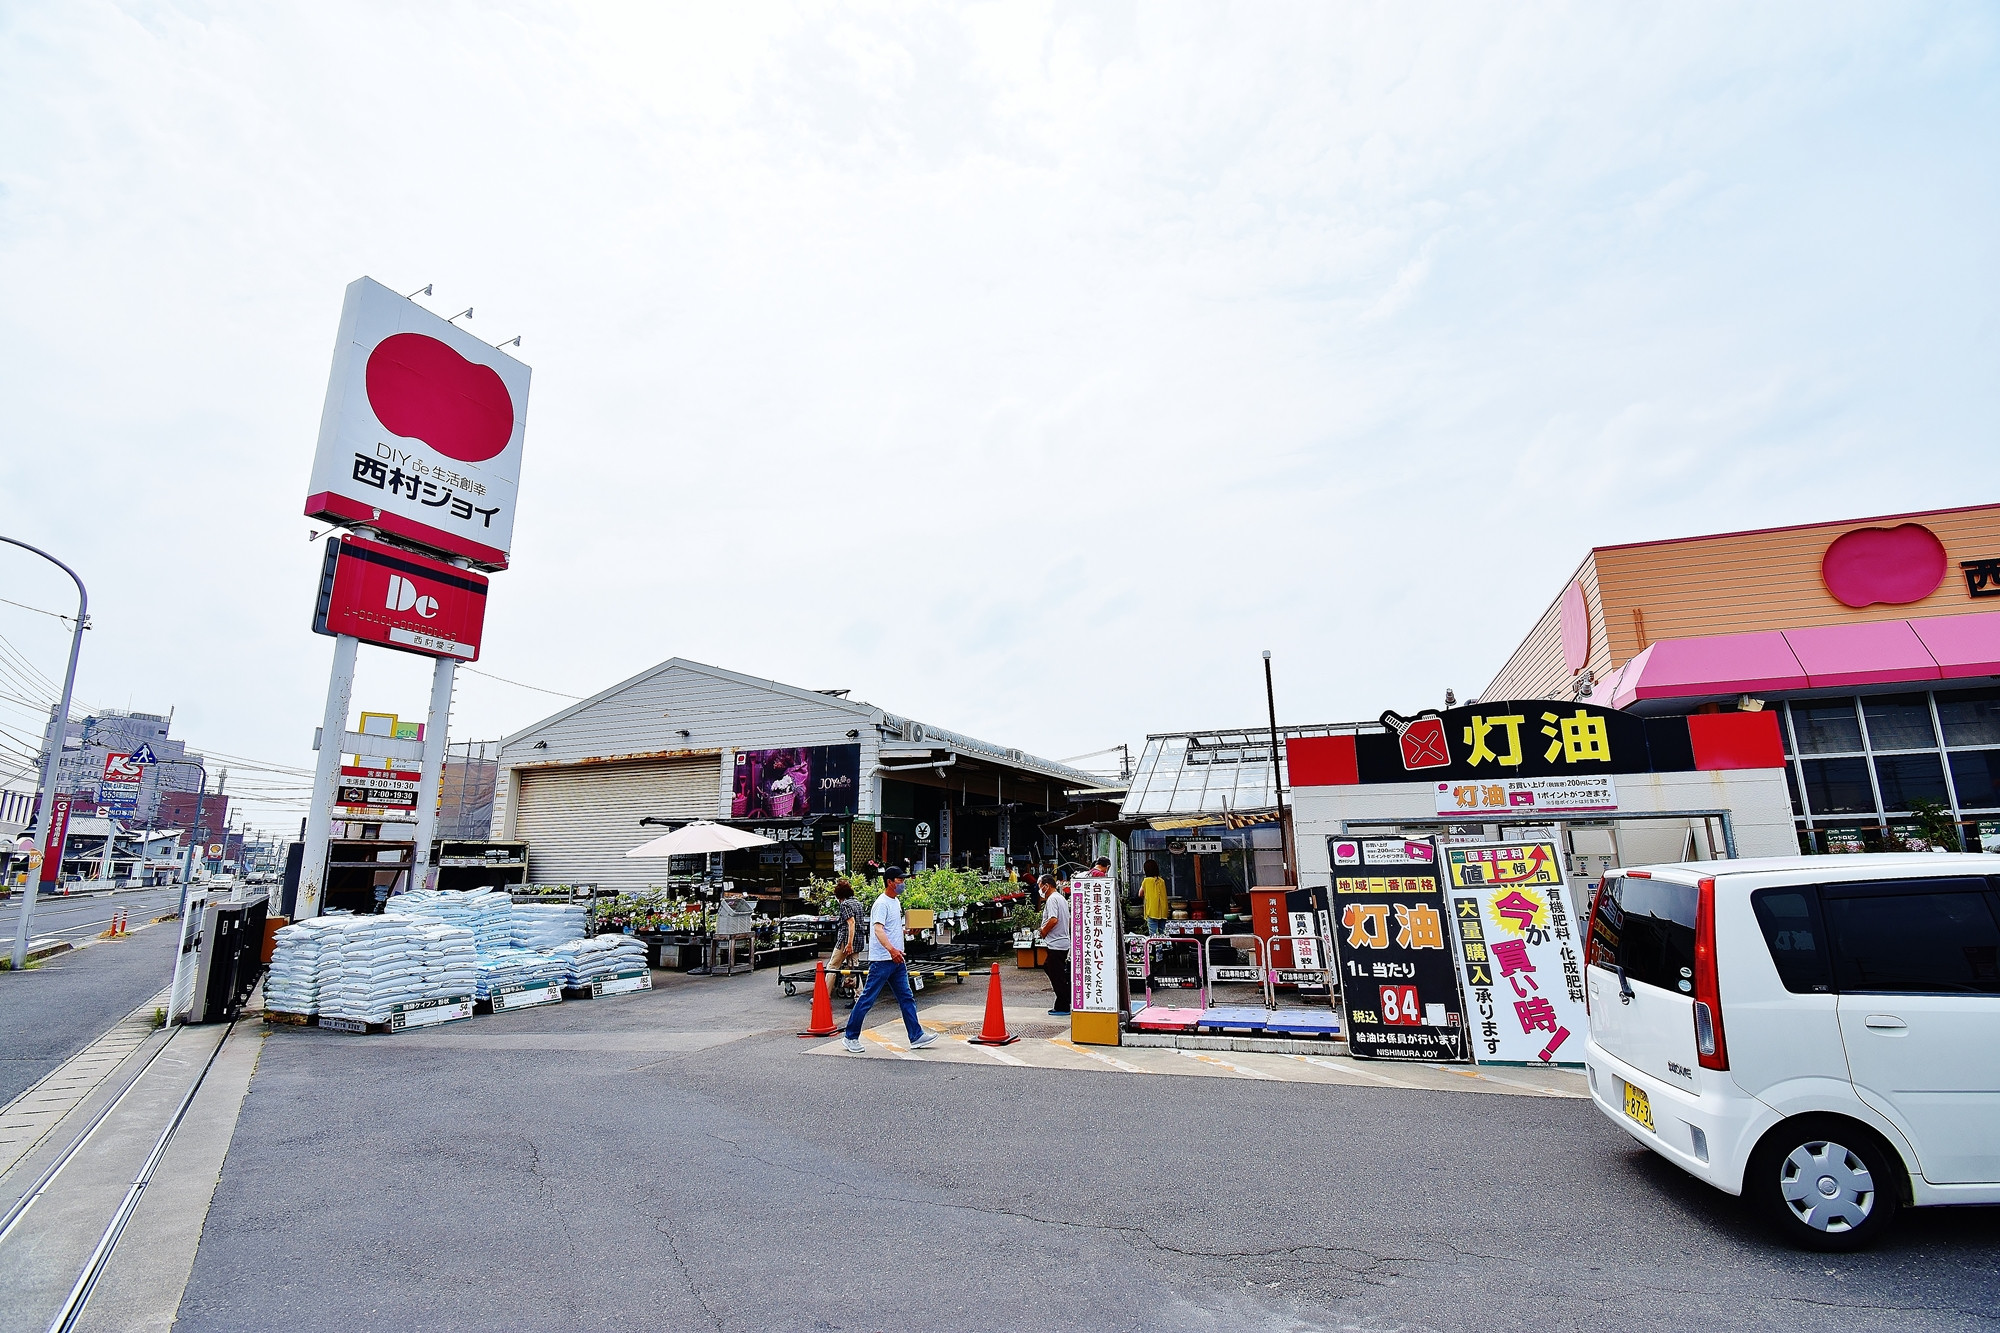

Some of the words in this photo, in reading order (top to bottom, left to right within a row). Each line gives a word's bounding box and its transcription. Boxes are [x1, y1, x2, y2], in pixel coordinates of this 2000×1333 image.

[376, 442, 412, 466] DIY
[352, 452, 501, 528] 西村ジョイ
[432, 465, 487, 497] 生活創幸
[385, 574, 439, 619] De
[1463, 709, 1612, 767] 灯油
[346, 778, 366, 786] 生活館
[367, 770, 397, 779] 営業時間
[1453, 784, 1507, 808] 灯油
[1467, 849, 1523, 861] 園芸肥料
[1338, 879, 1435, 892] 地域一番価格
[1103, 881, 1112, 928] このあたりに
[1342, 903, 1444, 949] 灯油
[1092, 882, 1104, 1005] 台車を置かないでください
[1545, 888, 1585, 1003] 有機肥料・化成肥料
[1347, 960, 1369, 977] 1L
[1372, 961, 1416, 978] 当たり
[1352, 1009, 1379, 1024] 税込
[1382, 989, 1418, 1021] 84
[1356, 1031, 1459, 1046] 給油は係員が行います
[1376, 1048, 1421, 1057] NISHIMURA
[1422, 1050, 1439, 1058] JOY
